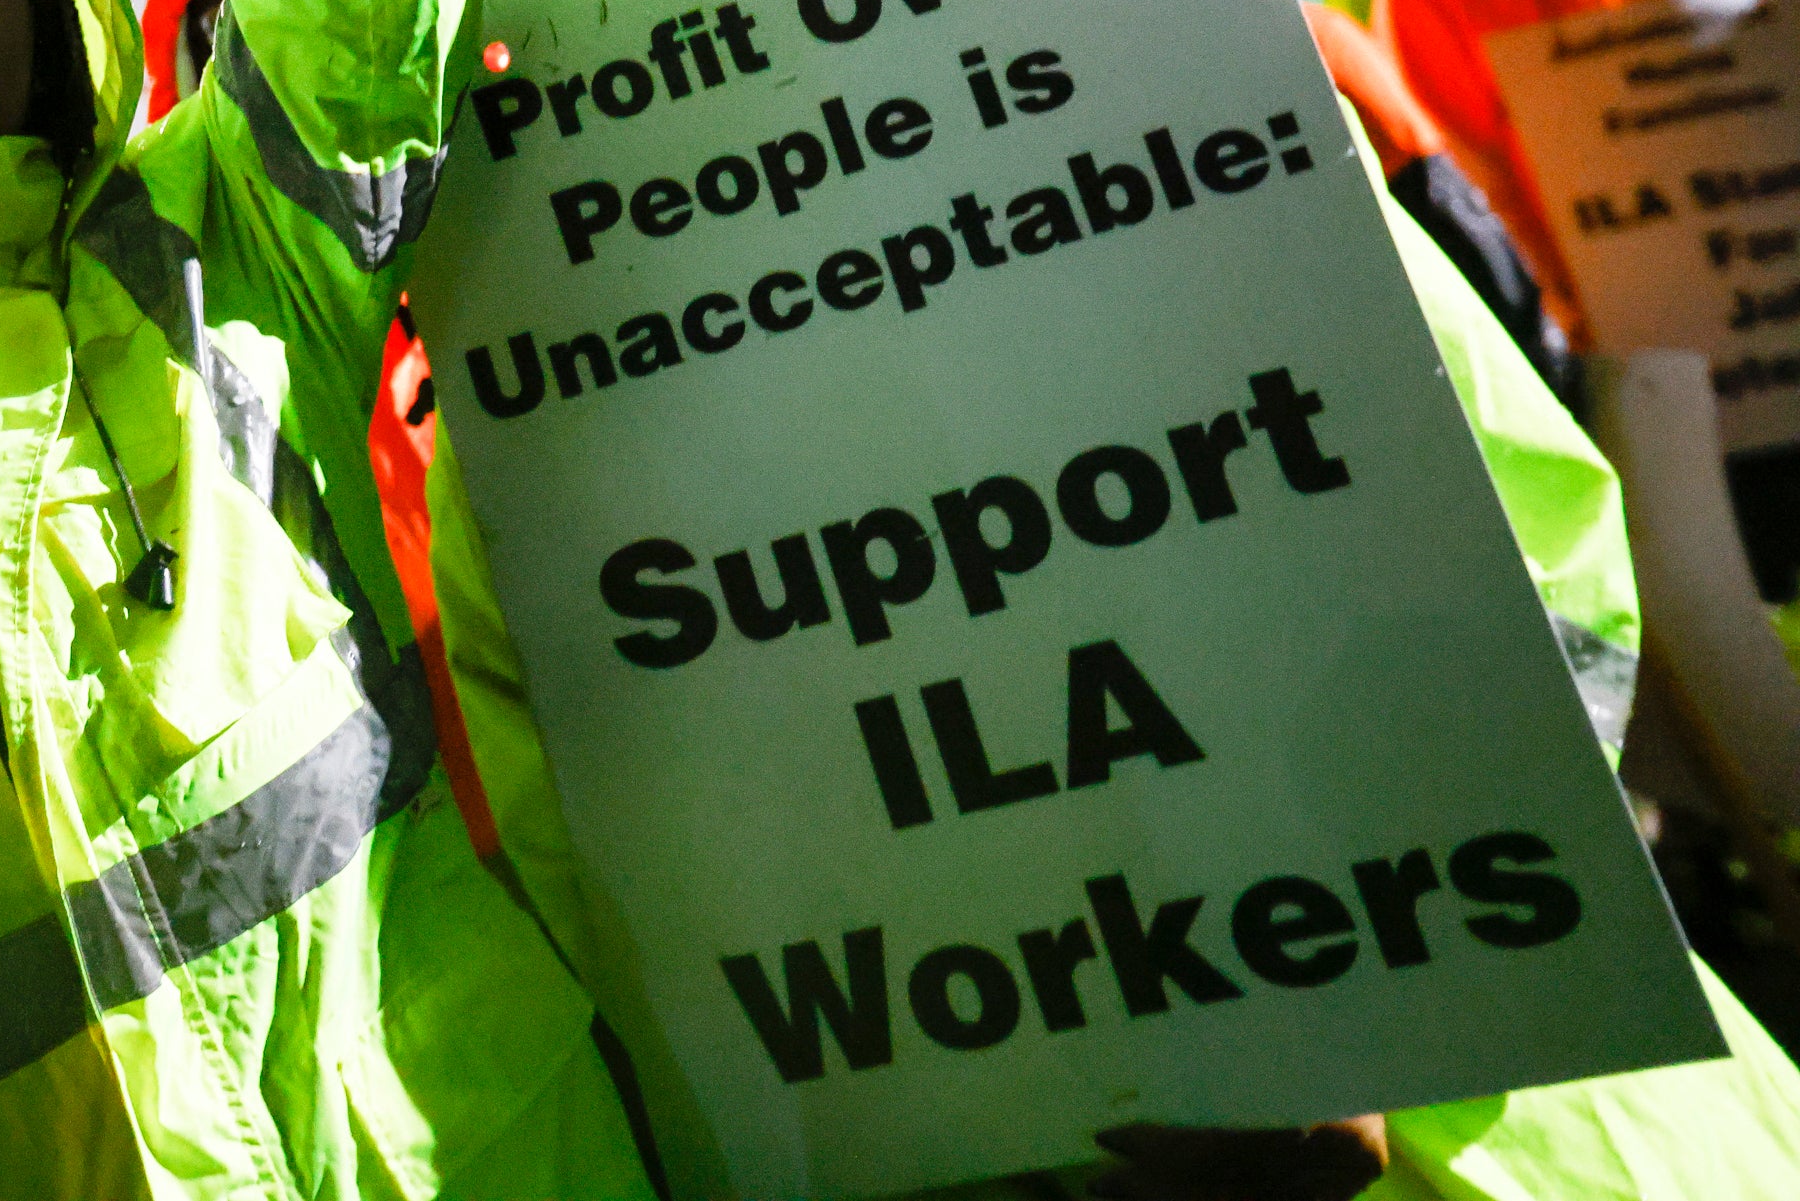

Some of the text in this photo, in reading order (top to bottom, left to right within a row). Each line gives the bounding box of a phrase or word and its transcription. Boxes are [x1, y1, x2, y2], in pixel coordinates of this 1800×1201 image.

[470, 2, 770, 160] Profit
[550, 46, 1075, 264] People is
[465, 110, 1315, 420] Unacceptable:
[598, 366, 1352, 672] Support
[853, 638, 1206, 831] ILA
[719, 829, 1583, 1085] Workers
